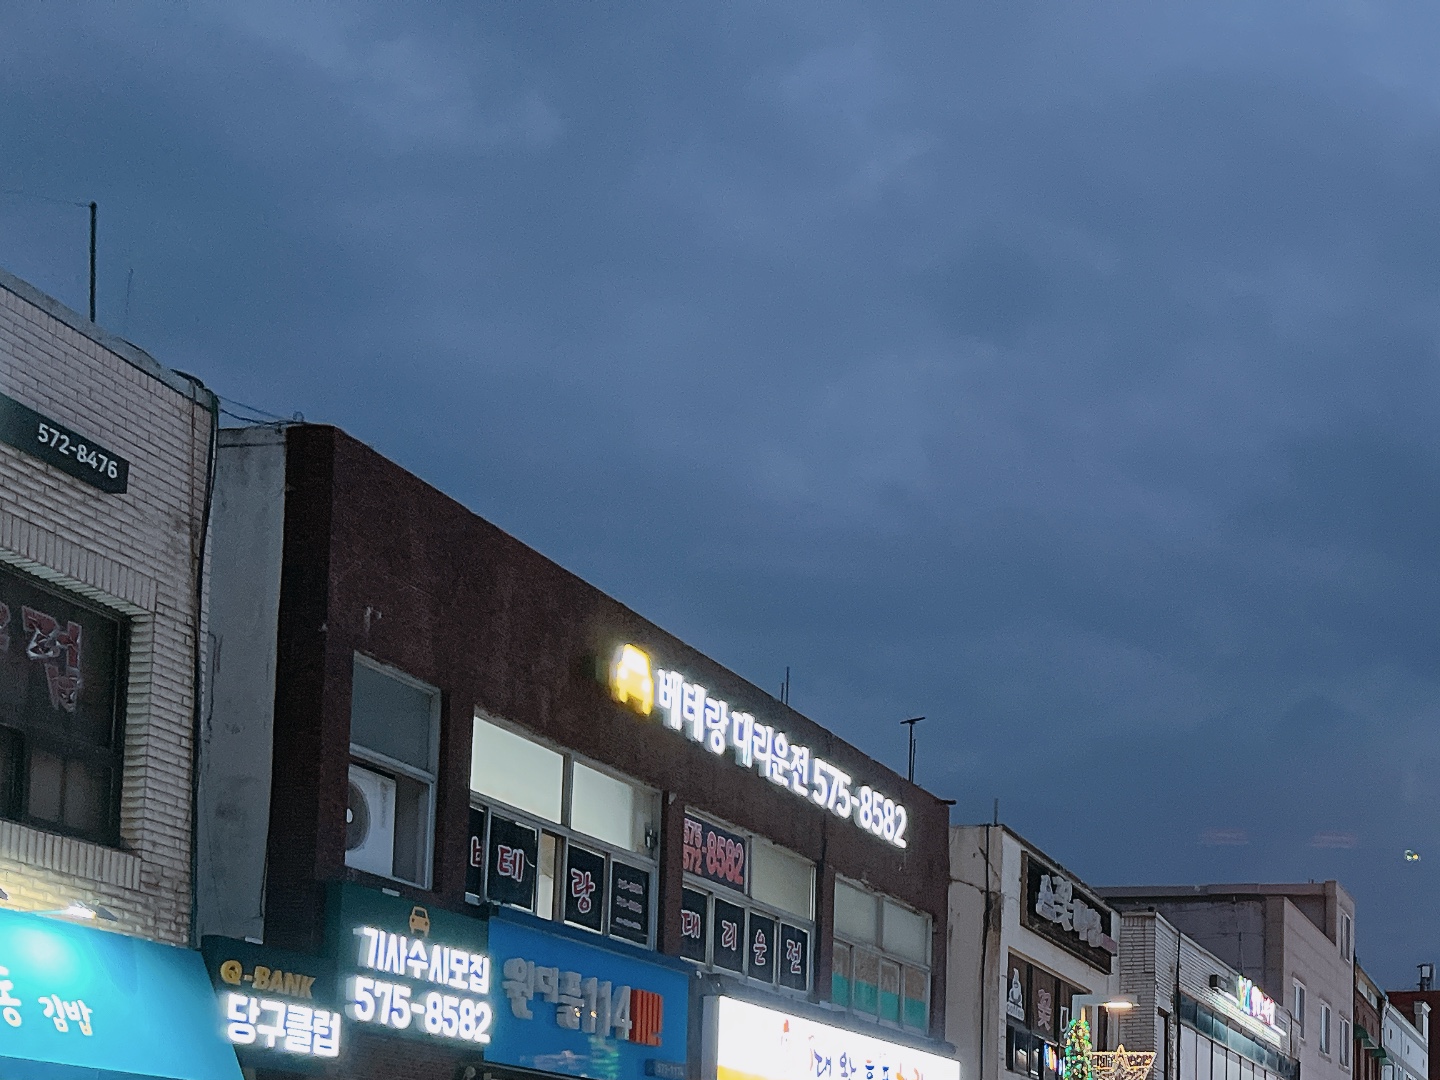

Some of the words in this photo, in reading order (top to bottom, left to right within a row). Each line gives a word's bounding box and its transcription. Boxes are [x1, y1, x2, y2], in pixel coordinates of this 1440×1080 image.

[38, 422, 118, 479] 572-8476
[657, 668, 730, 756] 베테랑
[731, 710, 811, 798] 대리운전
[812, 756, 908, 849] 575-8582
[219, 959, 316, 999] Q-BANK
[353, 974, 493, 1045] 575-8582
[38, 993, 94, 1037] 김밥
[226, 992, 342, 1058] 당구클럽
